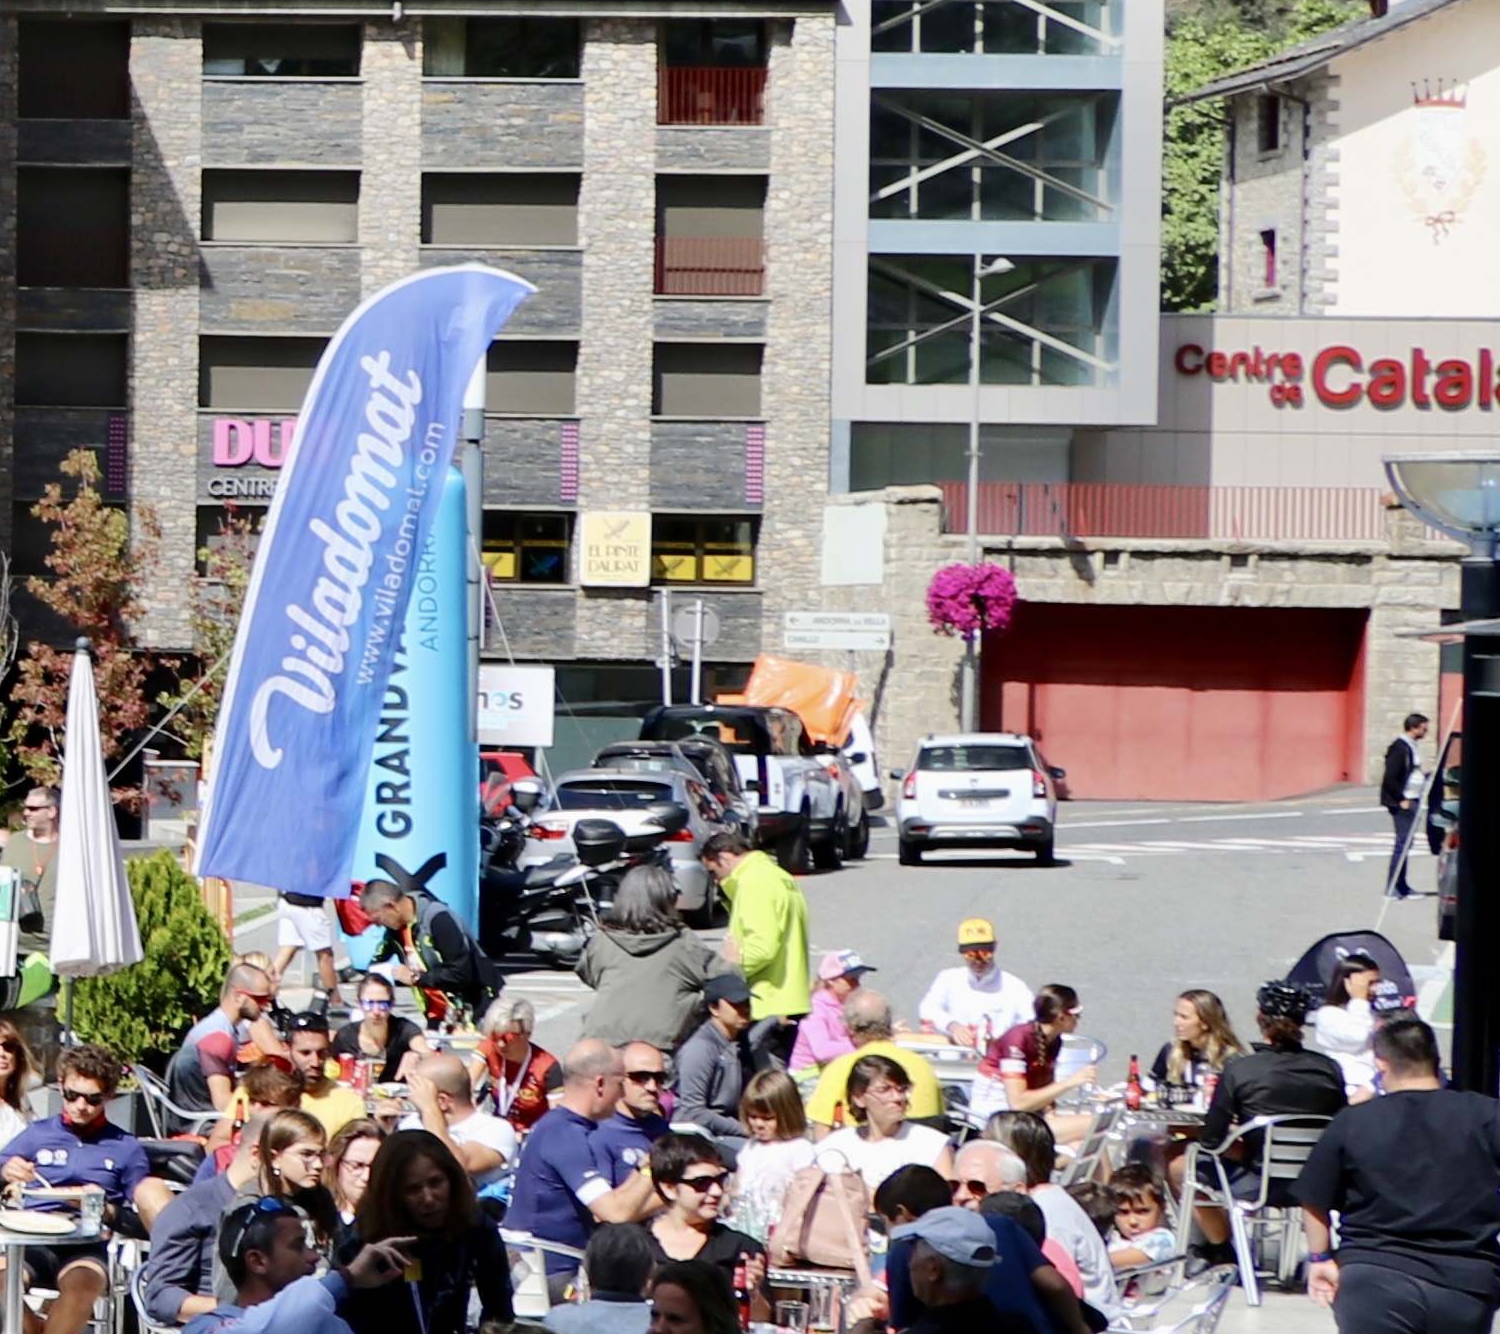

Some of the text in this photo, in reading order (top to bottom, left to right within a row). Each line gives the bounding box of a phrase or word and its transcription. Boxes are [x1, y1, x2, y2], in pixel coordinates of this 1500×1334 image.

[1174, 343, 1303, 381] Centre
[1269, 381, 1303, 406] de
[213, 418, 299, 468] DU
[248, 349, 424, 770] Viladomat
[355, 421, 446, 687] www.viladomat.com
[588, 545, 602, 558] EL
